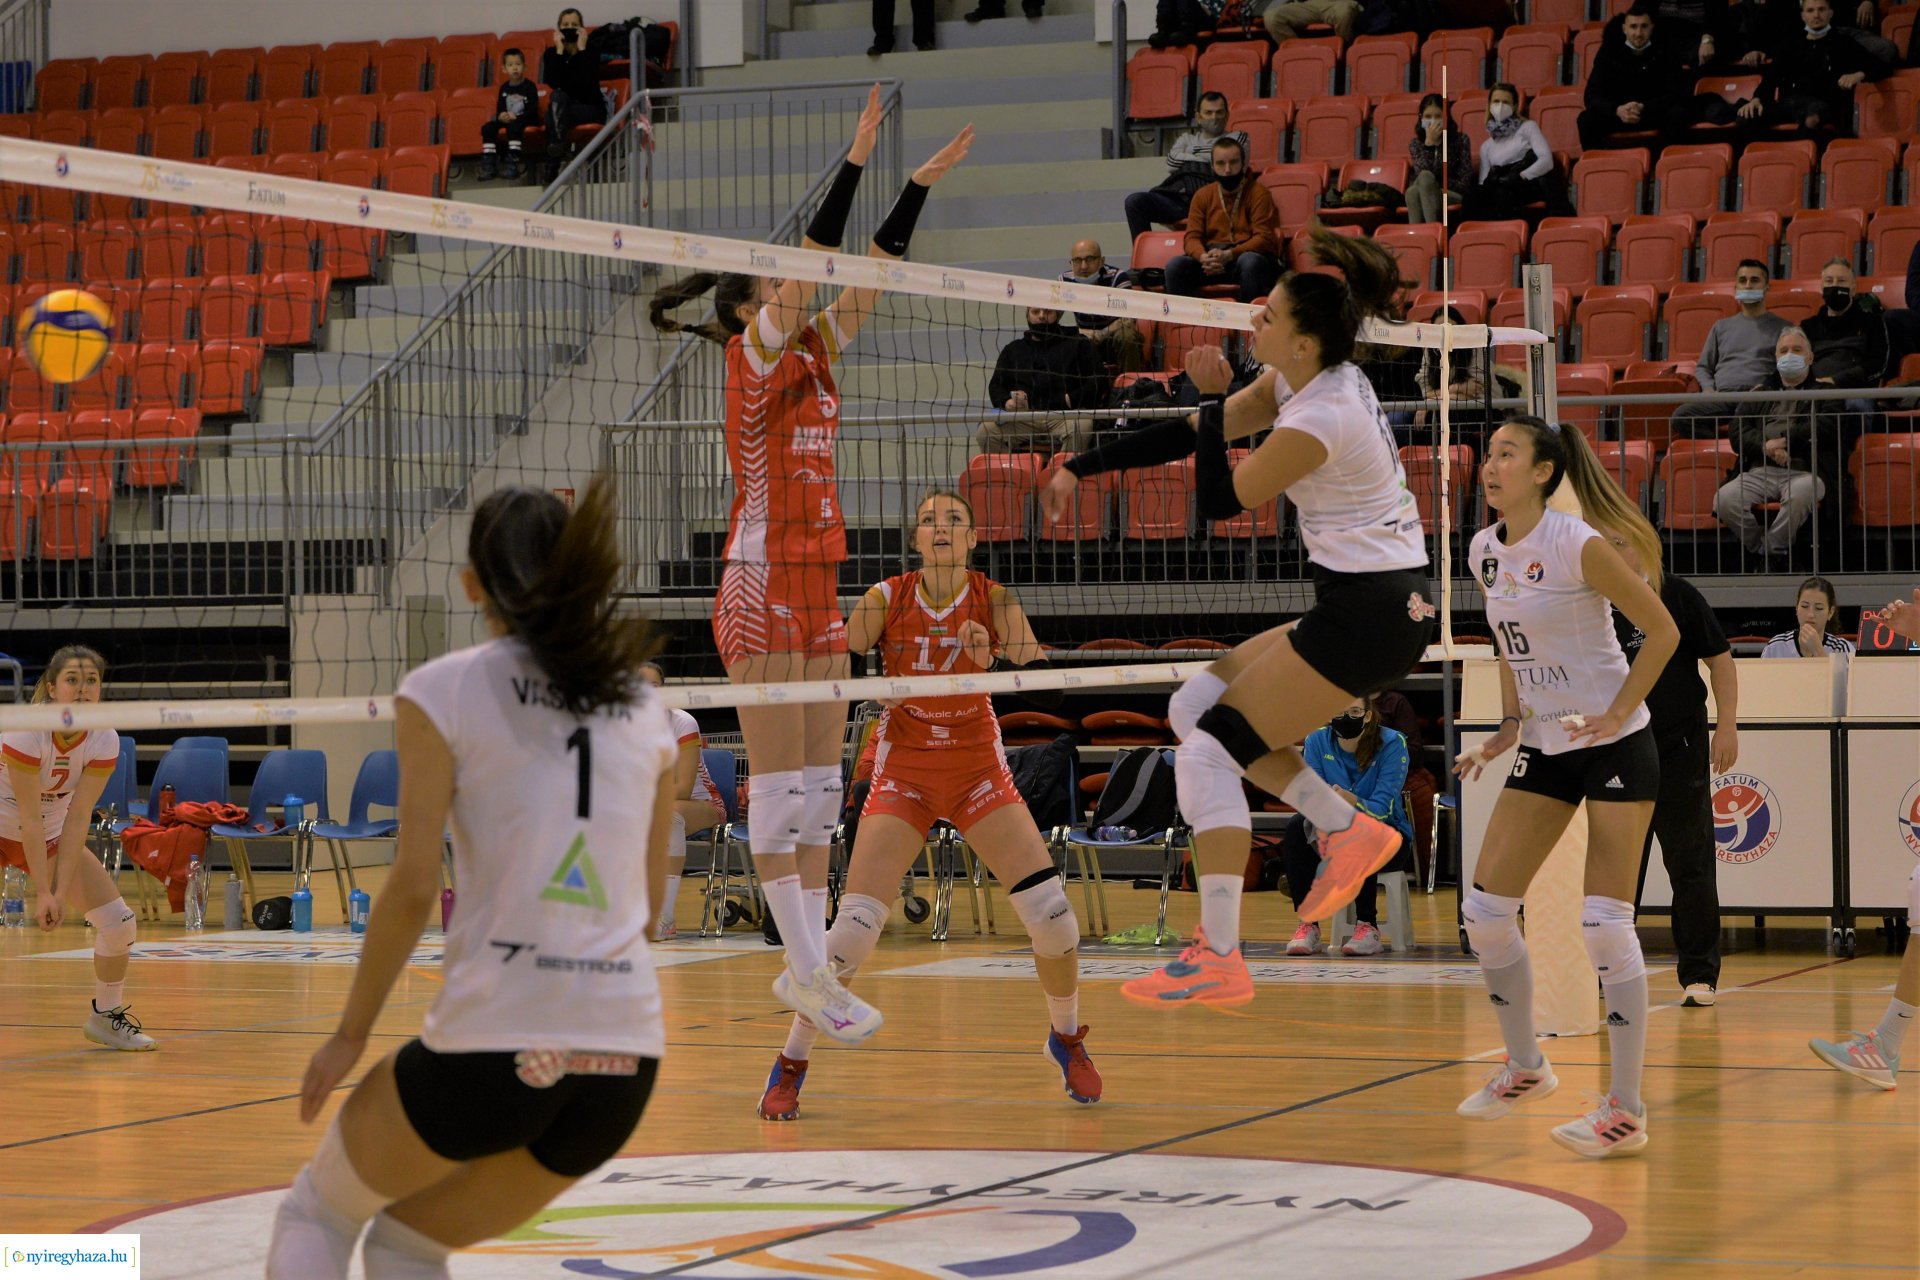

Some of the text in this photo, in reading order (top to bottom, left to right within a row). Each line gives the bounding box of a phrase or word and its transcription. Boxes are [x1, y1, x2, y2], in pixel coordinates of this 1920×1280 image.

[247, 181, 286, 206] FATUM
[523, 219, 555, 240] FATUM
[750, 249, 777, 269] FATUM
[1498, 620, 1530, 655] 15
[1873, 621, 1894, 649] 0
[912, 636, 962, 672] 17
[51, 768, 70, 791] 7
[566, 727, 591, 818] 1
[1715, 776, 1759, 789] FATUM
[967, 789, 1005, 815] SEAT
[852, 916, 872, 930] MIKASA
[1050, 908, 1068, 921] MIKASA
